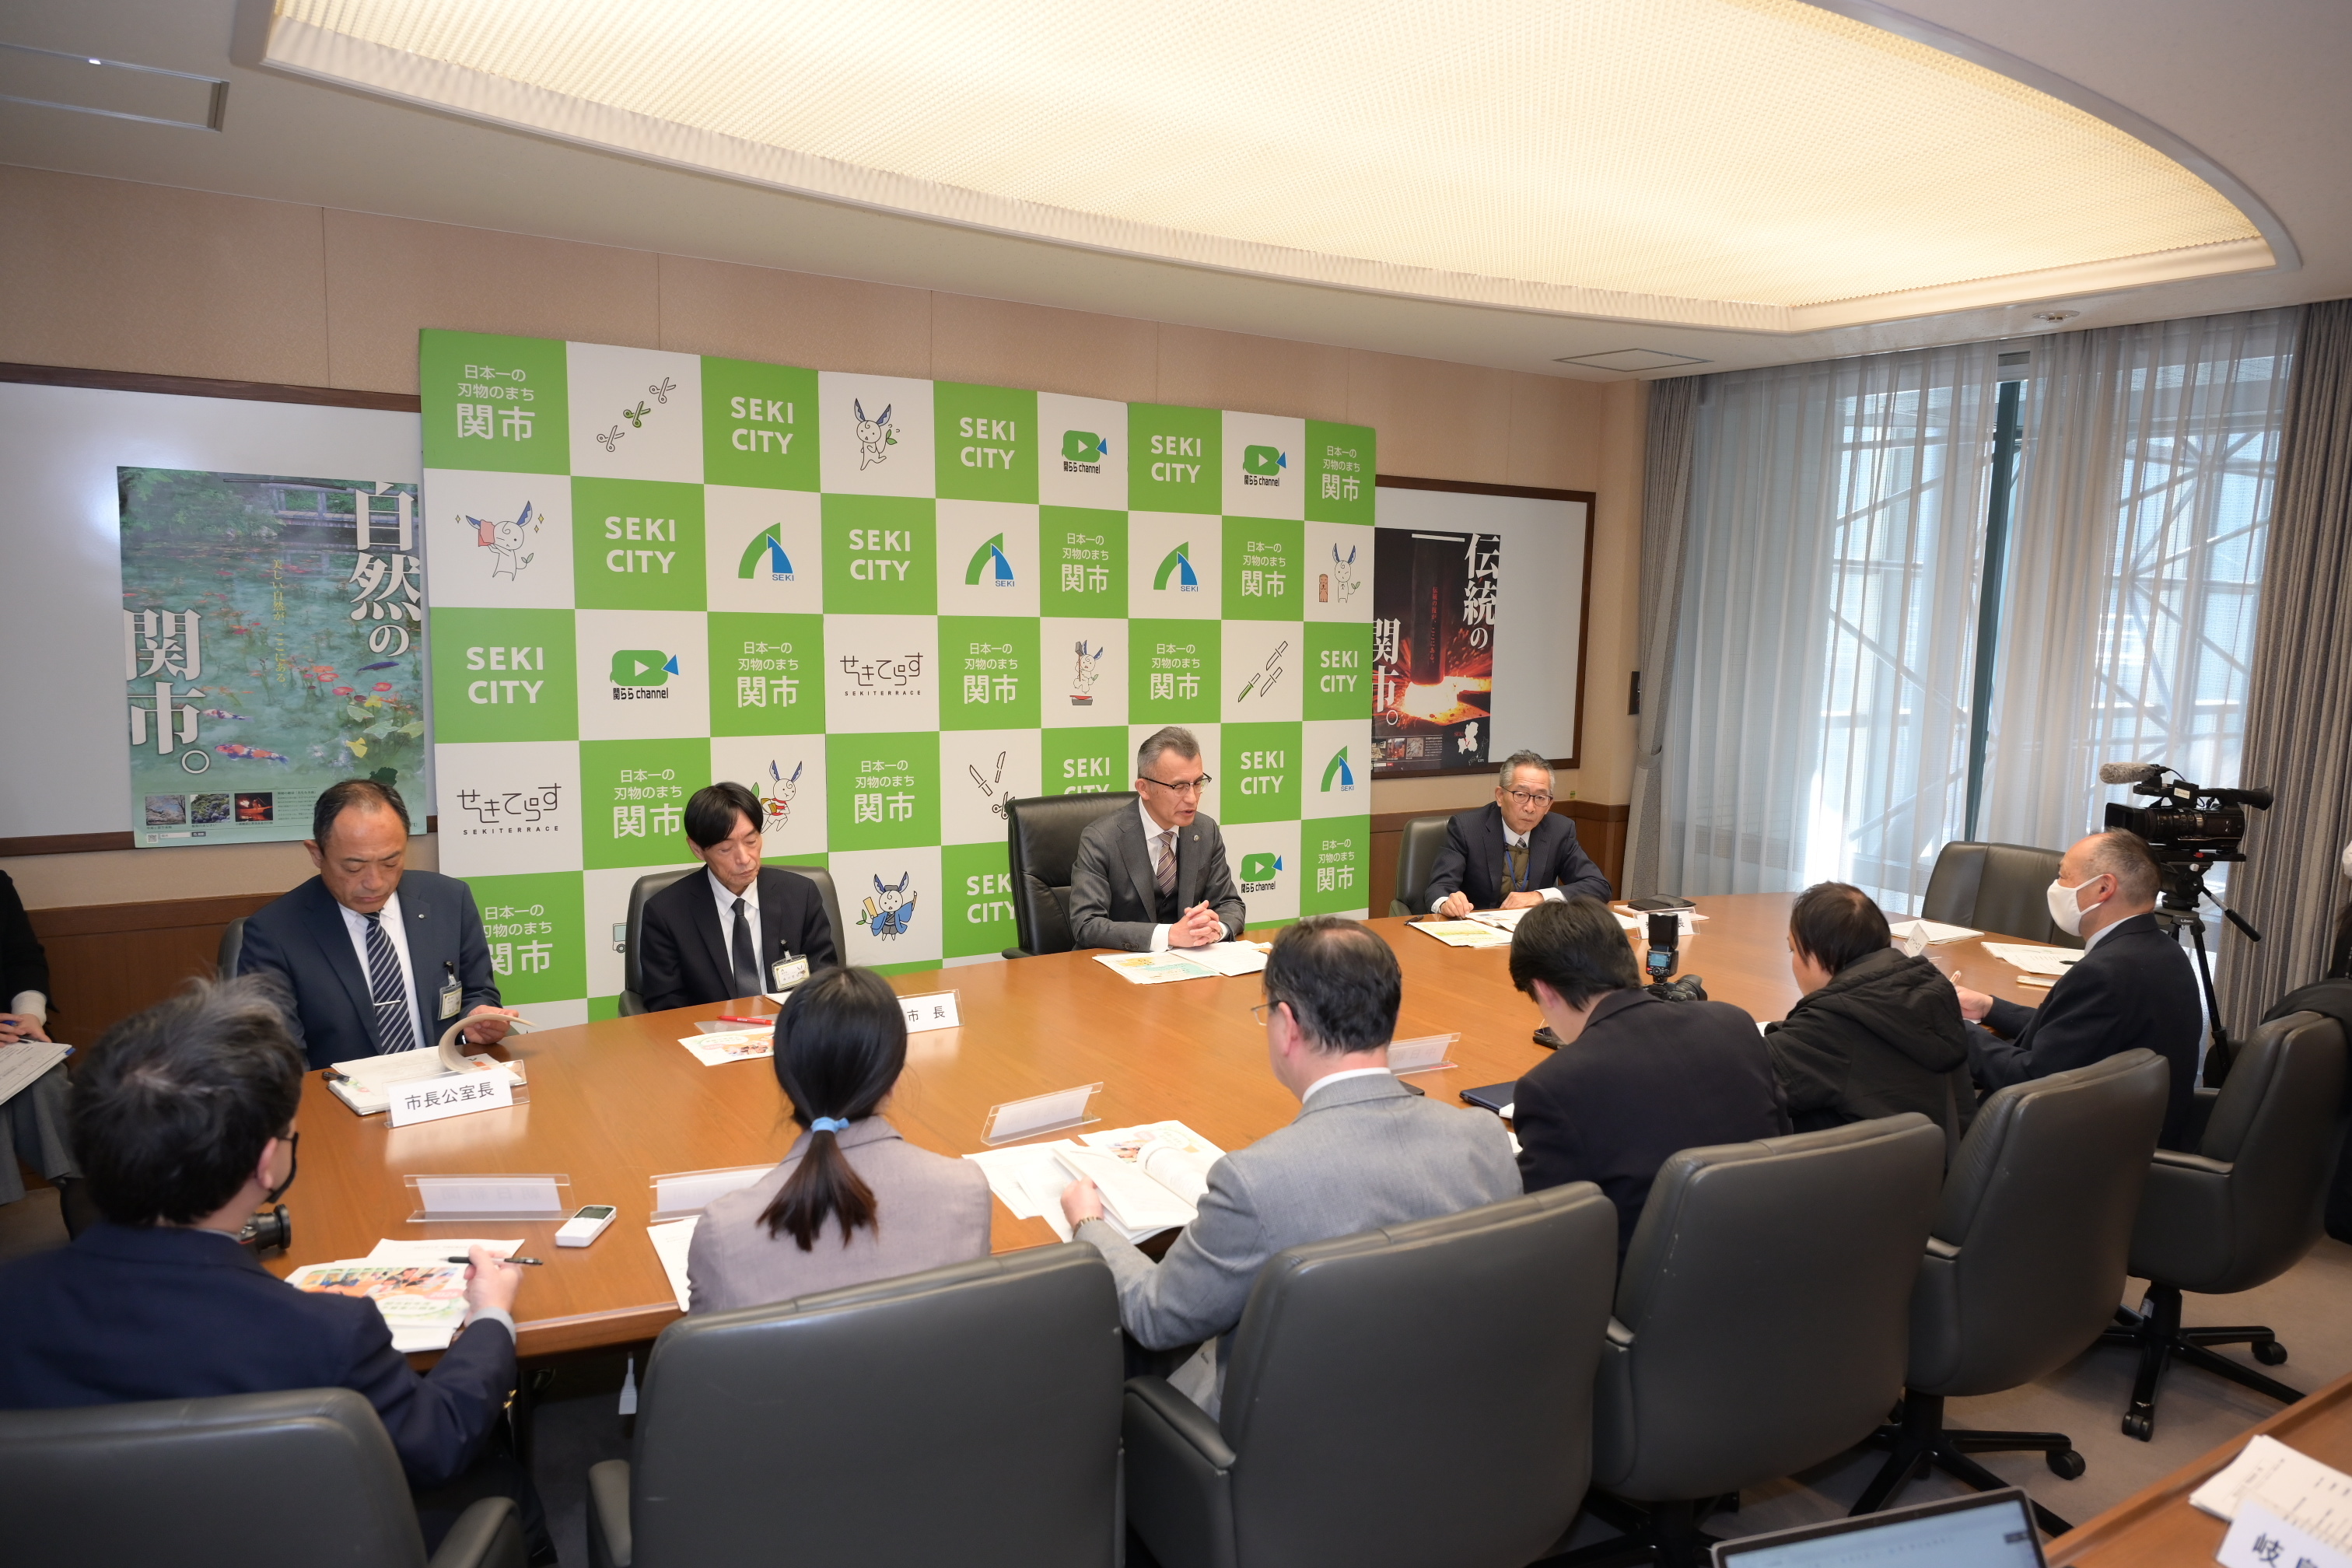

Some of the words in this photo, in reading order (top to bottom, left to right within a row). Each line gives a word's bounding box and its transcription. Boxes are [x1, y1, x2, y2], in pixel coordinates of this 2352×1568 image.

[464, 365, 526, 383] 日本一の
[457, 382, 534, 401] 刃物のまち
[731, 397, 793, 423] SEKI
[457, 403, 535, 442] 関市
[960, 418, 1014, 441] SEKI
[733, 429, 793, 454] CITY
[1151, 436, 1200, 457] SEKI
[961, 446, 1014, 469] CITY
[1326, 446, 1356, 459] 日本一の
[1063, 460, 1078, 473] 関らら
[1079, 463, 1101, 474] channel
[1152, 463, 1200, 483] CITY
[1323, 459, 1360, 472] 刃物のまち
[1244, 474, 1258, 486] 関らら
[1258, 476, 1279, 487] channel
[1322, 474, 1360, 501] 関市
[605, 516, 675, 541] SEKI
[849, 530, 910, 551] SEKI
[1068, 534, 1104, 545] 日本一の
[1248, 541, 1281, 552] 日本一の
[607, 550, 675, 573] CITY
[1062, 548, 1108, 560] 刃物のまち
[1243, 555, 1285, 566] 刃物のまち
[349, 481, 421, 656] 自然の
[772, 573, 794, 582] SEKI
[850, 559, 910, 580] CITY
[1062, 564, 1108, 593] 関市
[1242, 571, 1286, 597] 関市
[1463, 534, 1500, 649] 伝統の
[744, 642, 792, 654] 日本一の
[971, 643, 1012, 654] 日本一の
[1157, 643, 1195, 654] 日本一の
[467, 647, 543, 670] SEKI
[739, 658, 798, 670] 刃物のまち
[965, 658, 1017, 670] 刃物のまち
[1152, 658, 1199, 668] 刃物のまち
[1321, 651, 1357, 667] SEKI
[840, 653, 923, 686] せきてらす
[468, 681, 544, 704] CITY
[737, 676, 799, 708] 関市
[964, 674, 1018, 704] 関市
[1151, 673, 1200, 699] 関市
[1321, 675, 1357, 692] CITY
[613, 688, 634, 701] 関らら
[635, 687, 669, 699] channel
[862, 760, 908, 772] 日本一の
[1064, 758, 1109, 778] SEKI
[1241, 751, 1283, 769] SEKI
[621, 769, 674, 782] 日本一の
[856, 775, 914, 788] 刃物のまち
[1241, 775, 1283, 794] CITY
[614, 786, 681, 800] 刃物のまち
[457, 783, 561, 823] せきてらす
[855, 792, 915, 824] 関市
[614, 803, 683, 838] 関市
[464, 826, 558, 835] SEKITERRACE
[1323, 839, 1351, 850] 日本一の
[1318, 851, 1355, 864] 刃物のまち
[967, 873, 1012, 896] SEK
[1241, 883, 1254, 894] 関らら
[1255, 880, 1276, 891] channel
[1318, 865, 1354, 892] 関市
[485, 905, 544, 920] 日本一の
[968, 901, 1016, 923] CITY
[404, 1081, 495, 1111] 市長公室長
